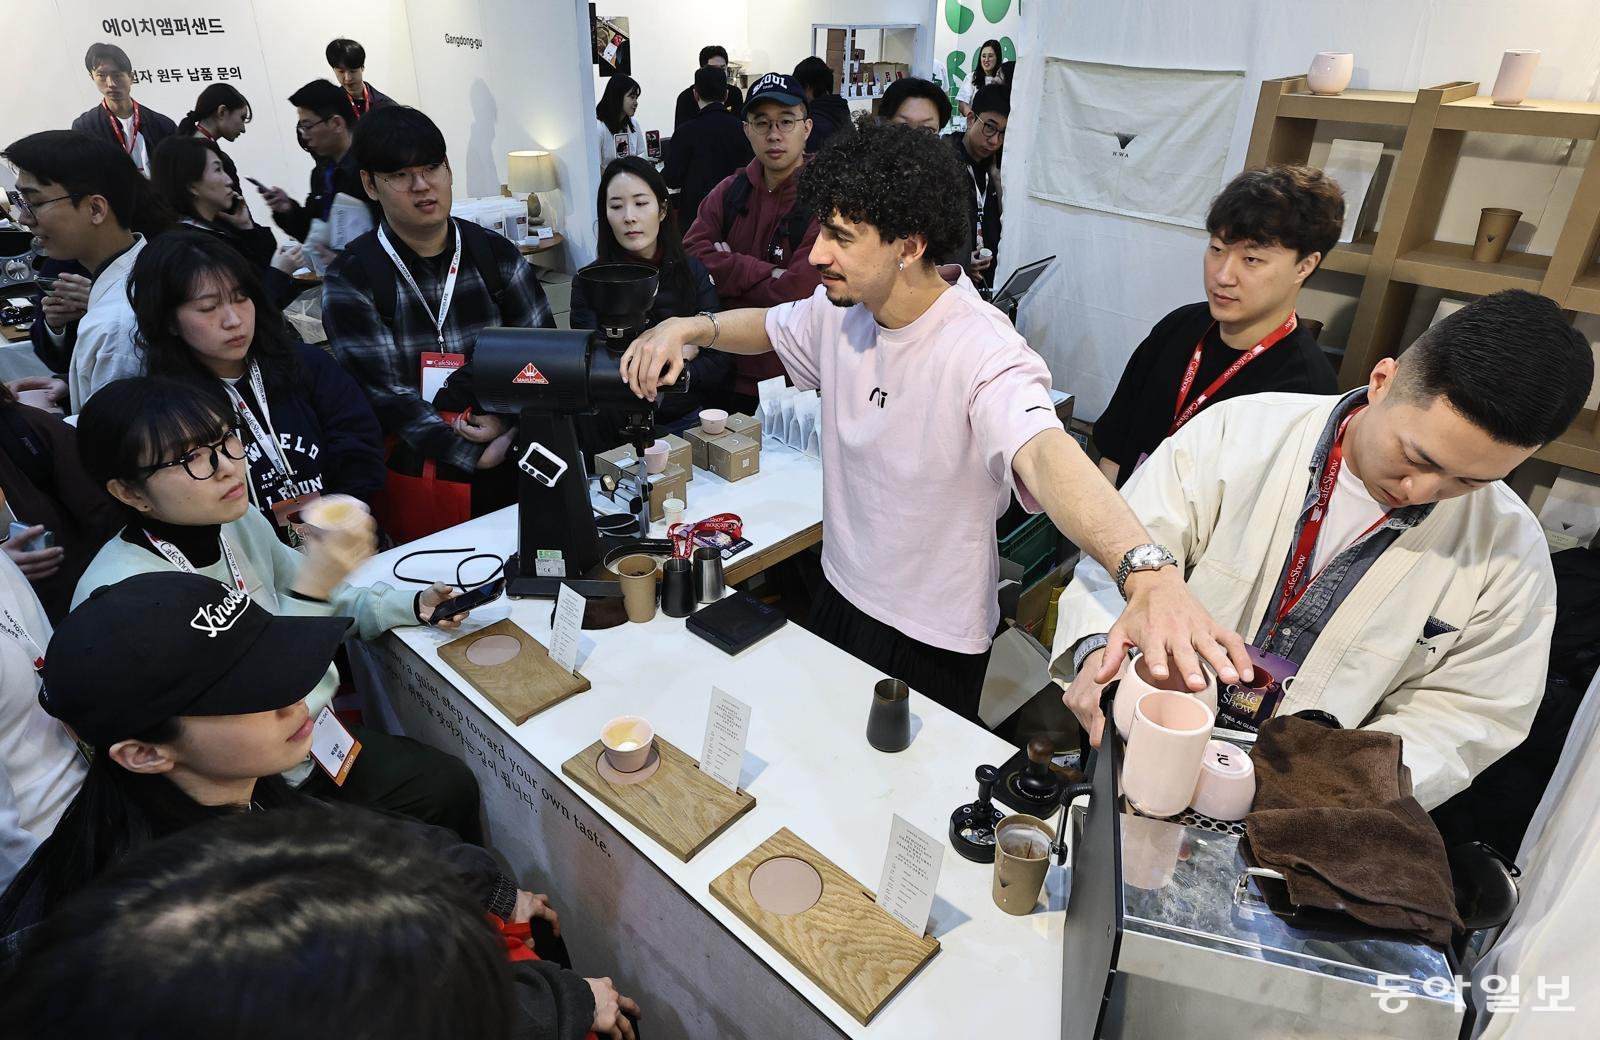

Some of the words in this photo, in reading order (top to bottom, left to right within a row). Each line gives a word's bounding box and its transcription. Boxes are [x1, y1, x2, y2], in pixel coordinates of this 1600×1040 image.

[102, 17, 225, 37] 에이치앰퍼샌드
[445, 33, 483, 50] Gangdong-gu
[157, 68, 184, 83] 원두
[187, 67, 213, 82] 납품
[217, 66, 242, 80] 문의
[752, 74, 788, 95] SEOUL
[1180, 361, 1198, 393] CafeShow
[1224, 352, 1254, 379] CafeShow
[243, 411, 265, 442] CafeShow
[277, 473, 324, 501] ROUN
[1316, 459, 1340, 508] CafeShow
[1284, 554, 1307, 598] CafeShow
[1416, 638, 1437, 654] WA
[1221, 692, 1254, 714] Show
[1226, 683, 1258, 704] Cafe
[407, 664, 414, 675] a
[415, 672, 441, 700] quiet
[442, 697, 464, 722] step
[466, 716, 506, 762] toward
[509, 757, 538, 789] your
[541, 788, 570, 819] own
[573, 814, 611, 858] taste.
[436, 712, 475, 754] 찾아가는
[477, 748, 498, 776] 길이
[500, 771, 539, 814] 됩니다.
